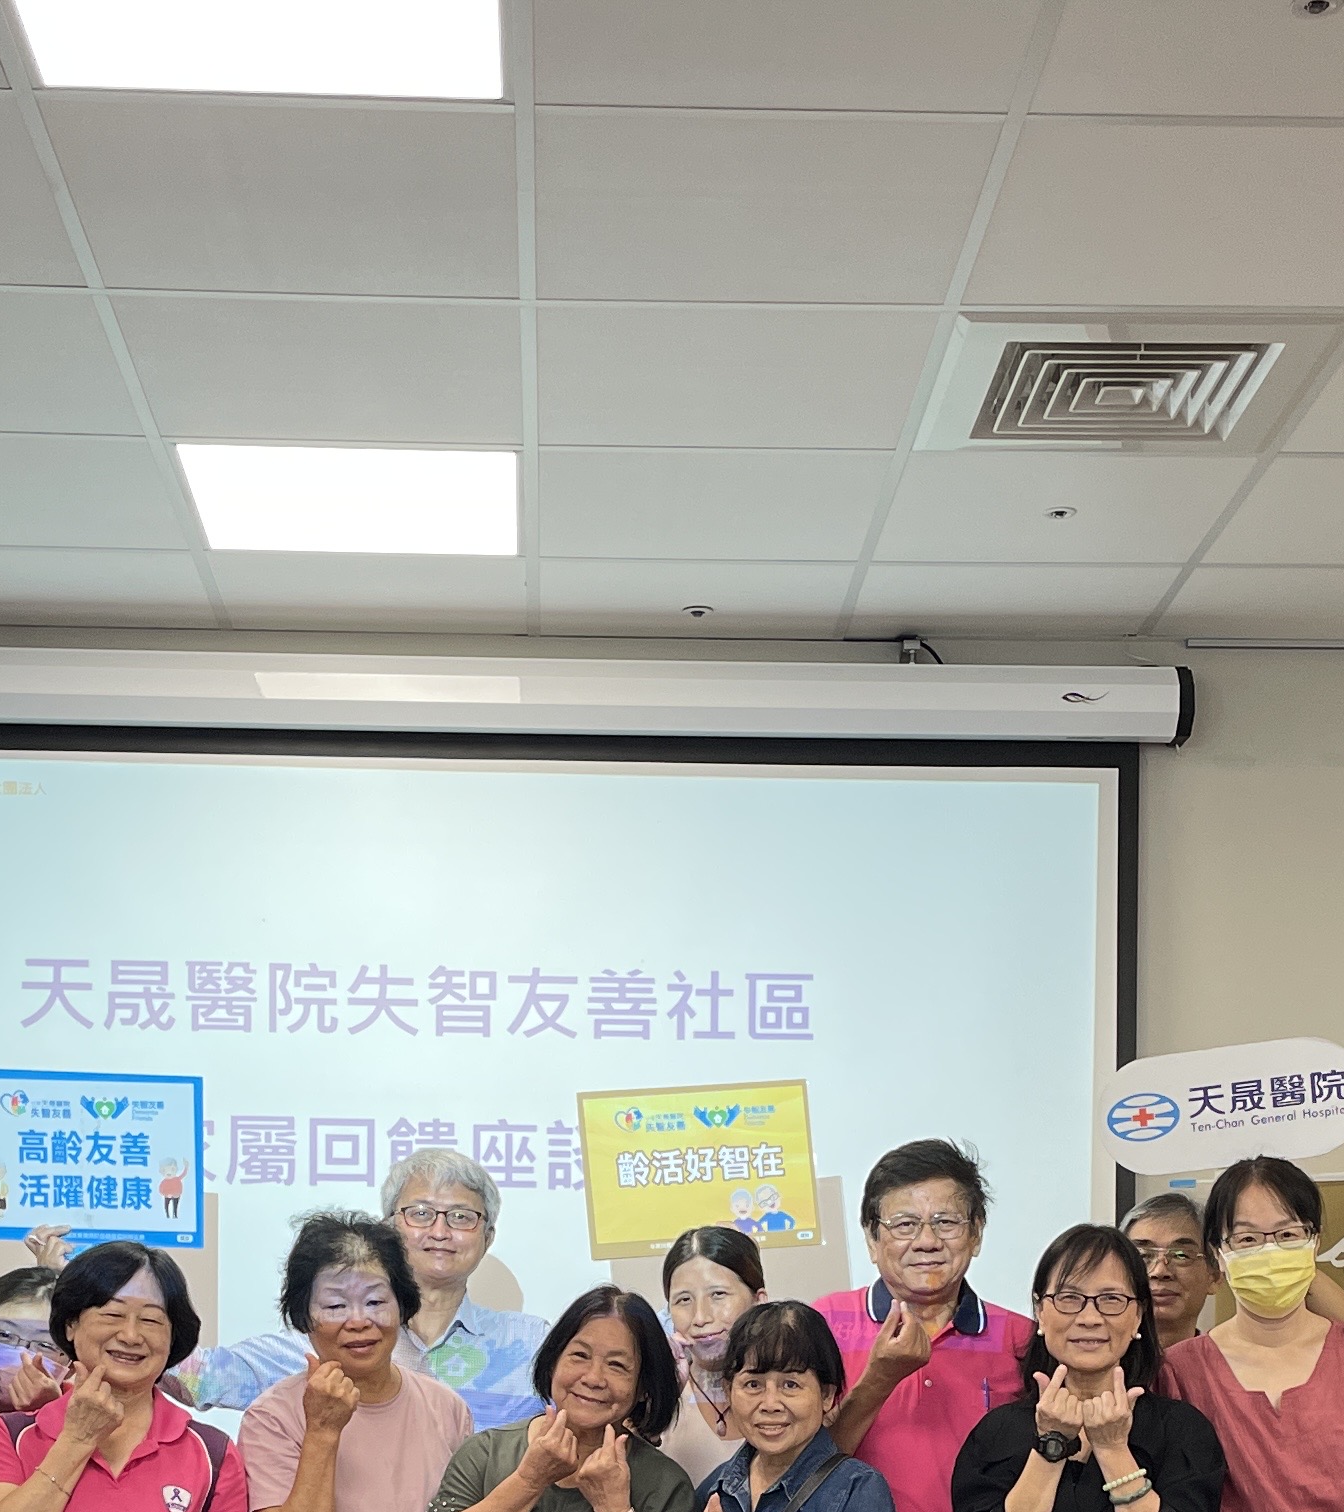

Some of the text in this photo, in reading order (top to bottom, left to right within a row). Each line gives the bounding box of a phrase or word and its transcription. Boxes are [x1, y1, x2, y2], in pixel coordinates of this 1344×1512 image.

[19, 957, 815, 1042] 天晟醫院失智友善社區
[1191, 1118, 1245, 1133] Ten-Chan
[1251, 1110, 1297, 1126] General
[17, 1129, 151, 1167] 高齡友善
[615, 1141, 786, 1188] 齡活好智在
[18, 1173, 153, 1211] 活躍健康
